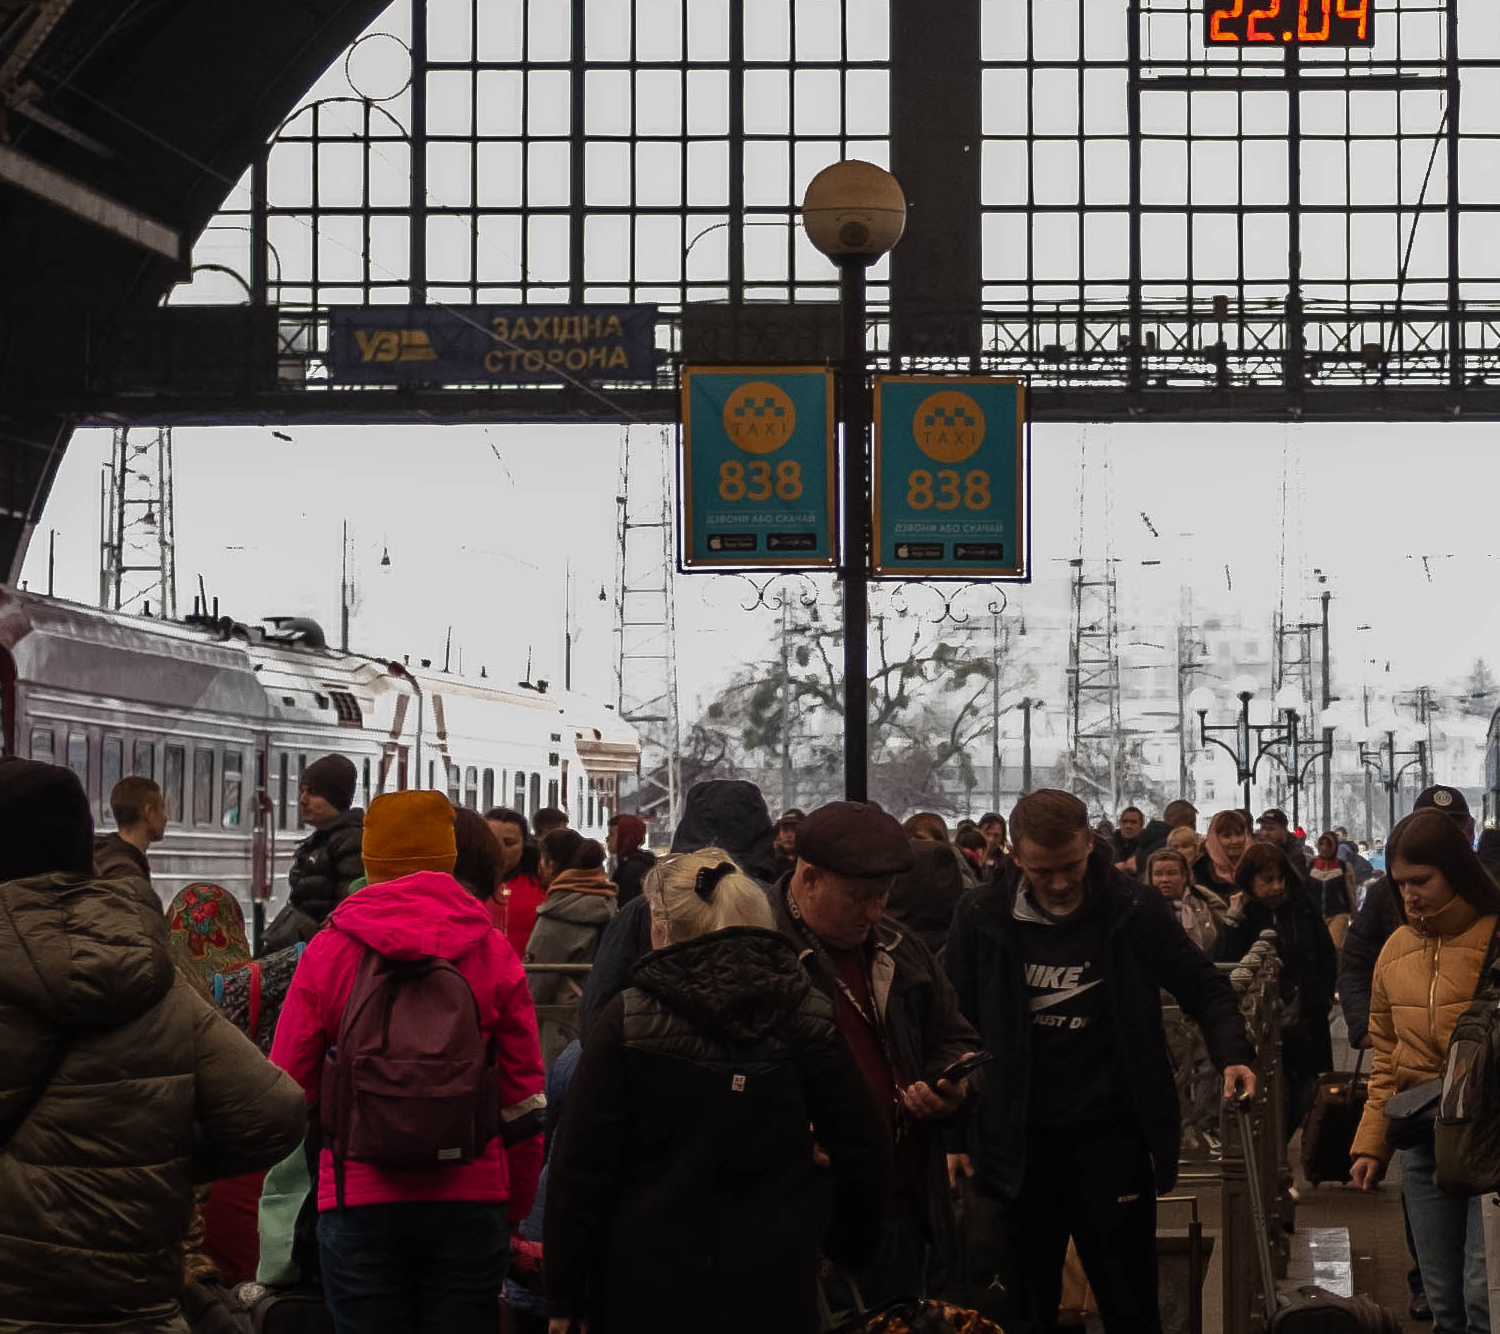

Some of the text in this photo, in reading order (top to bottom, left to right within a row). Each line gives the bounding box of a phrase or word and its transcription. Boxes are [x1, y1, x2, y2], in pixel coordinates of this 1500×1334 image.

[492, 314, 624, 345] ЗАХІДНА
[484, 347, 629, 374] СТОРОНА
[731, 422, 788, 437] TAXI
[923, 431, 978, 445] TAXI
[718, 459, 804, 501] 838
[906, 469, 992, 511] 838
[1023, 963, 1085, 989] NIKE
